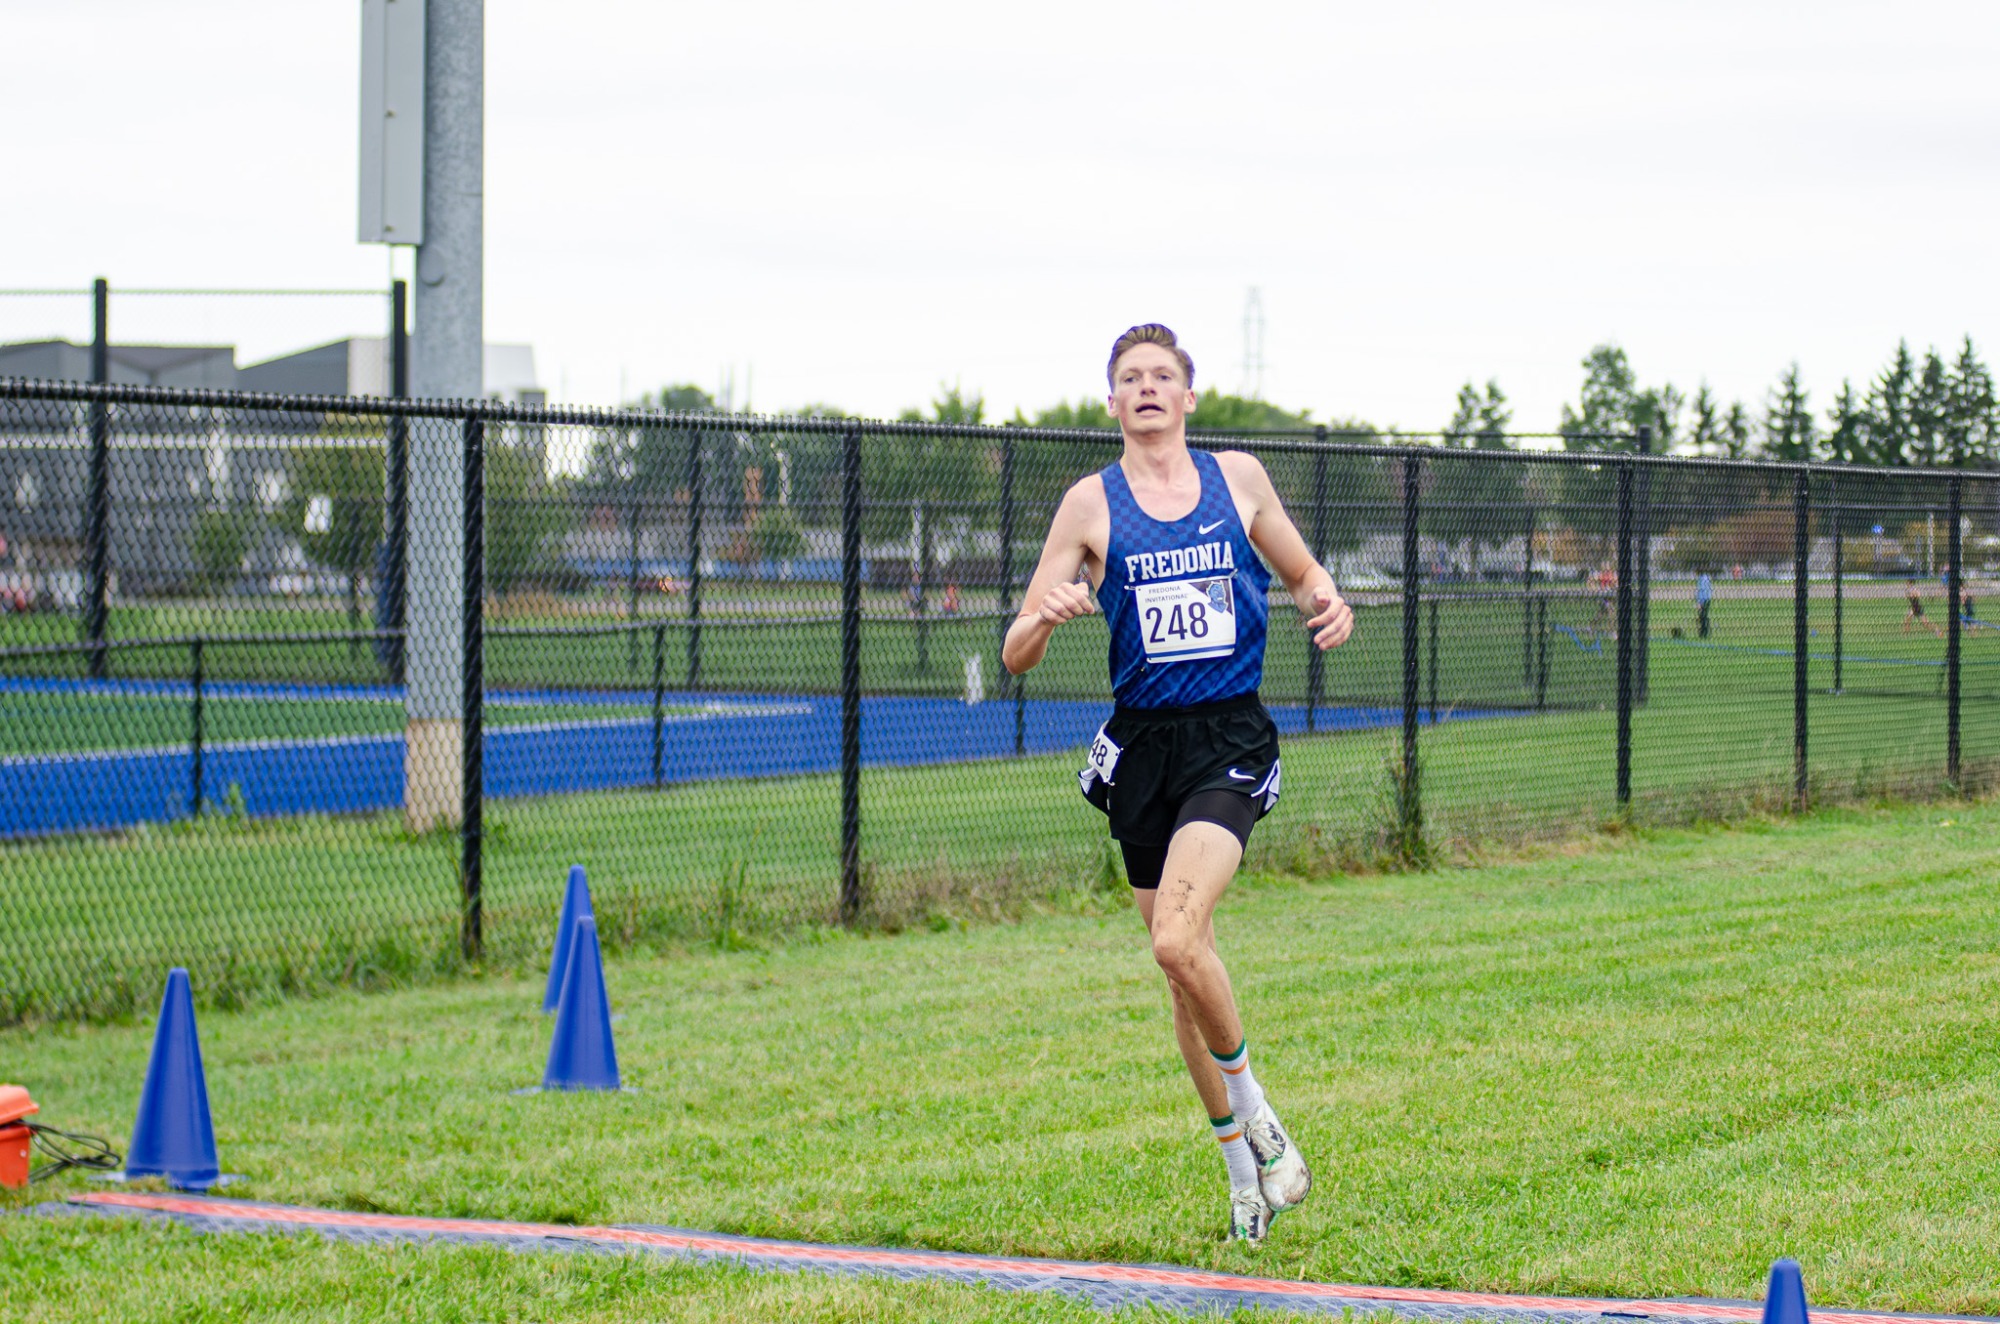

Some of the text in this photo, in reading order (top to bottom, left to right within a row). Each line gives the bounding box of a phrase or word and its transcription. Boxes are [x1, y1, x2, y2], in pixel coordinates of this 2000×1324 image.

[1125, 541, 1234, 582] FREDONIA
[1144, 593, 1188, 604] INVITATIONAL
[1148, 585, 1181, 595] FREDONIA
[1145, 601, 1209, 644] 248
